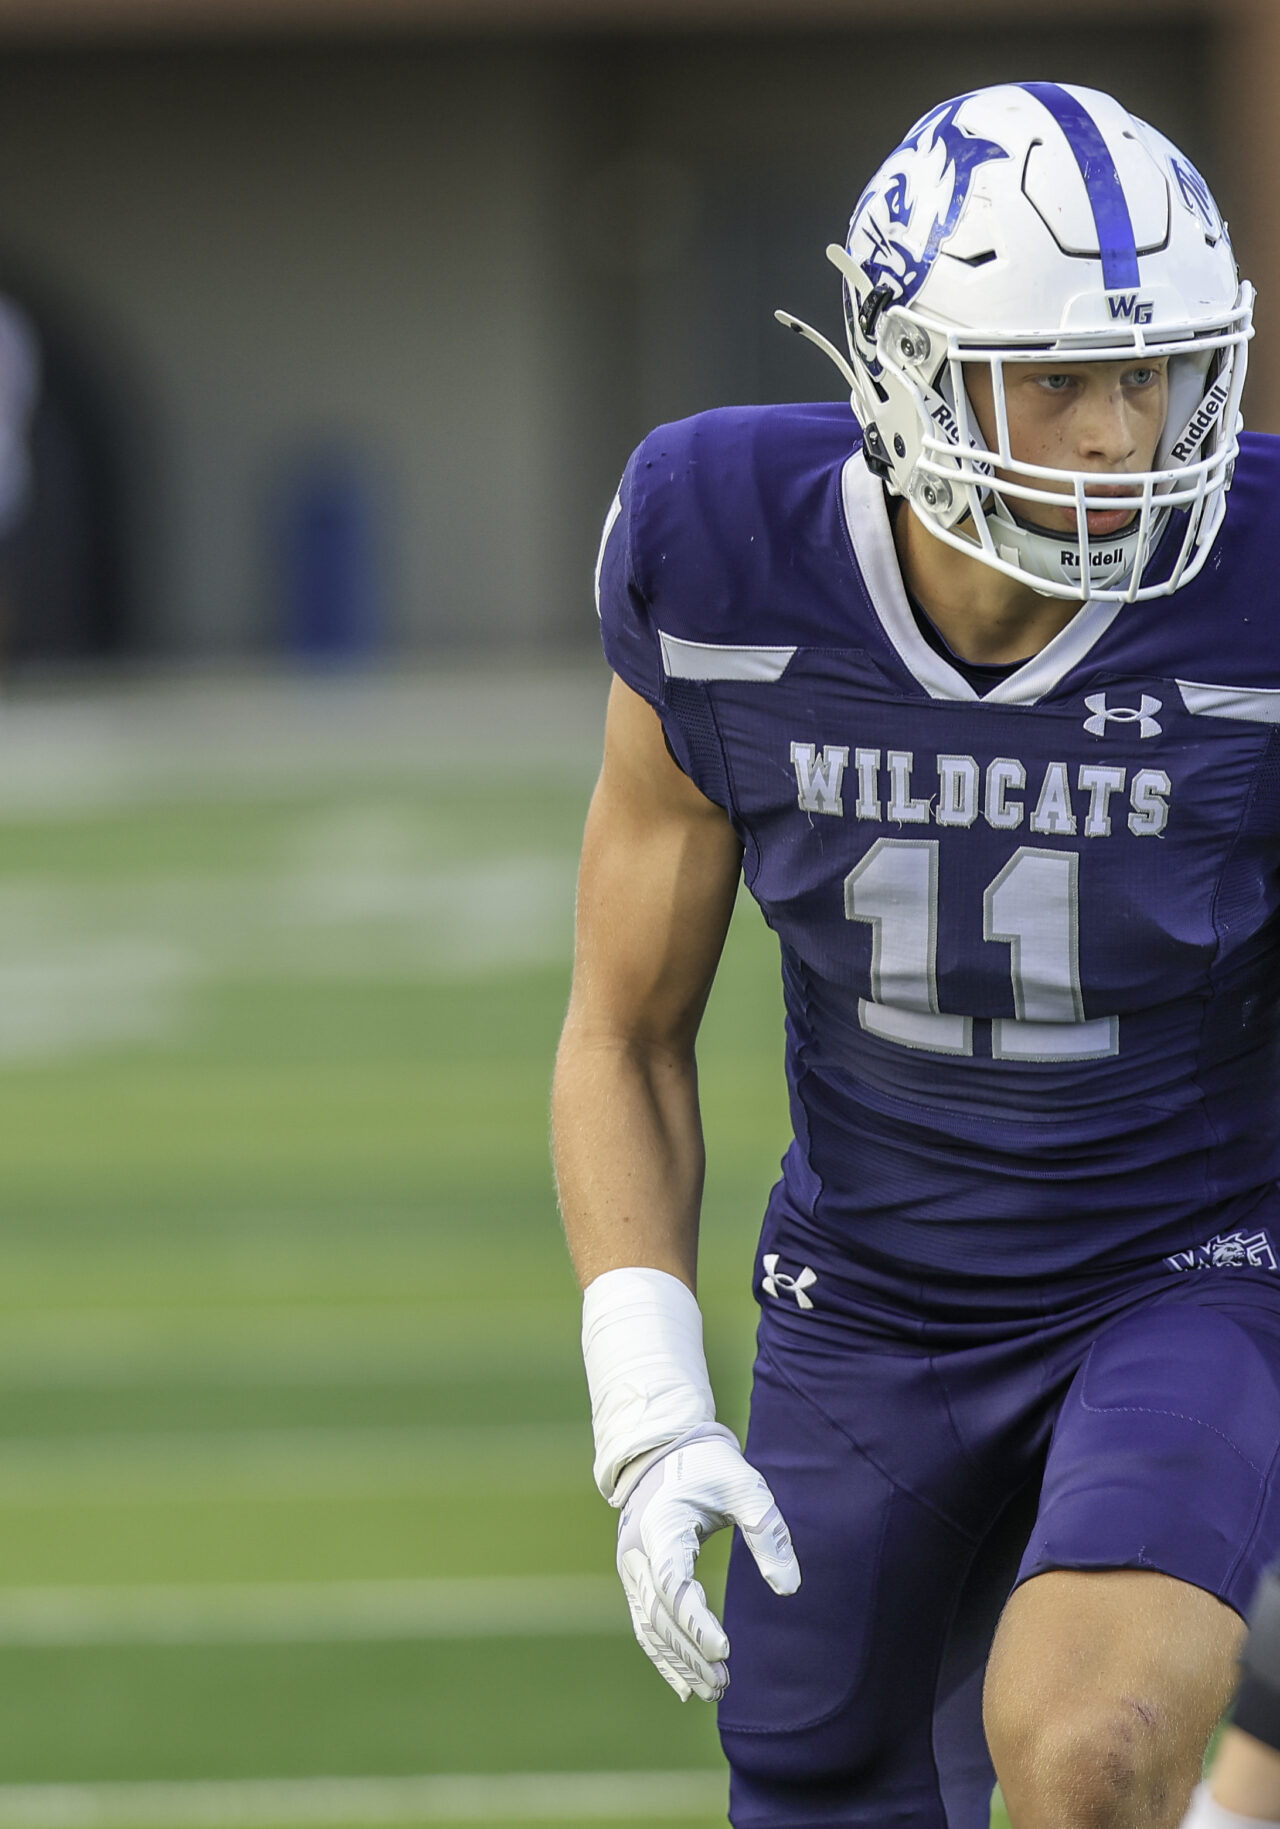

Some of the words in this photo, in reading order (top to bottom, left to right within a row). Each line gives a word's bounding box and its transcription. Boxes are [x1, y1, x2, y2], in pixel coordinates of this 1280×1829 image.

[1106, 293, 1154, 325] WG
[1170, 384, 1229, 462] Riddell
[1060, 547, 1124, 567] Ridell
[790, 740, 1172, 837] WILDCATS
[844, 837, 1120, 1063] 11
